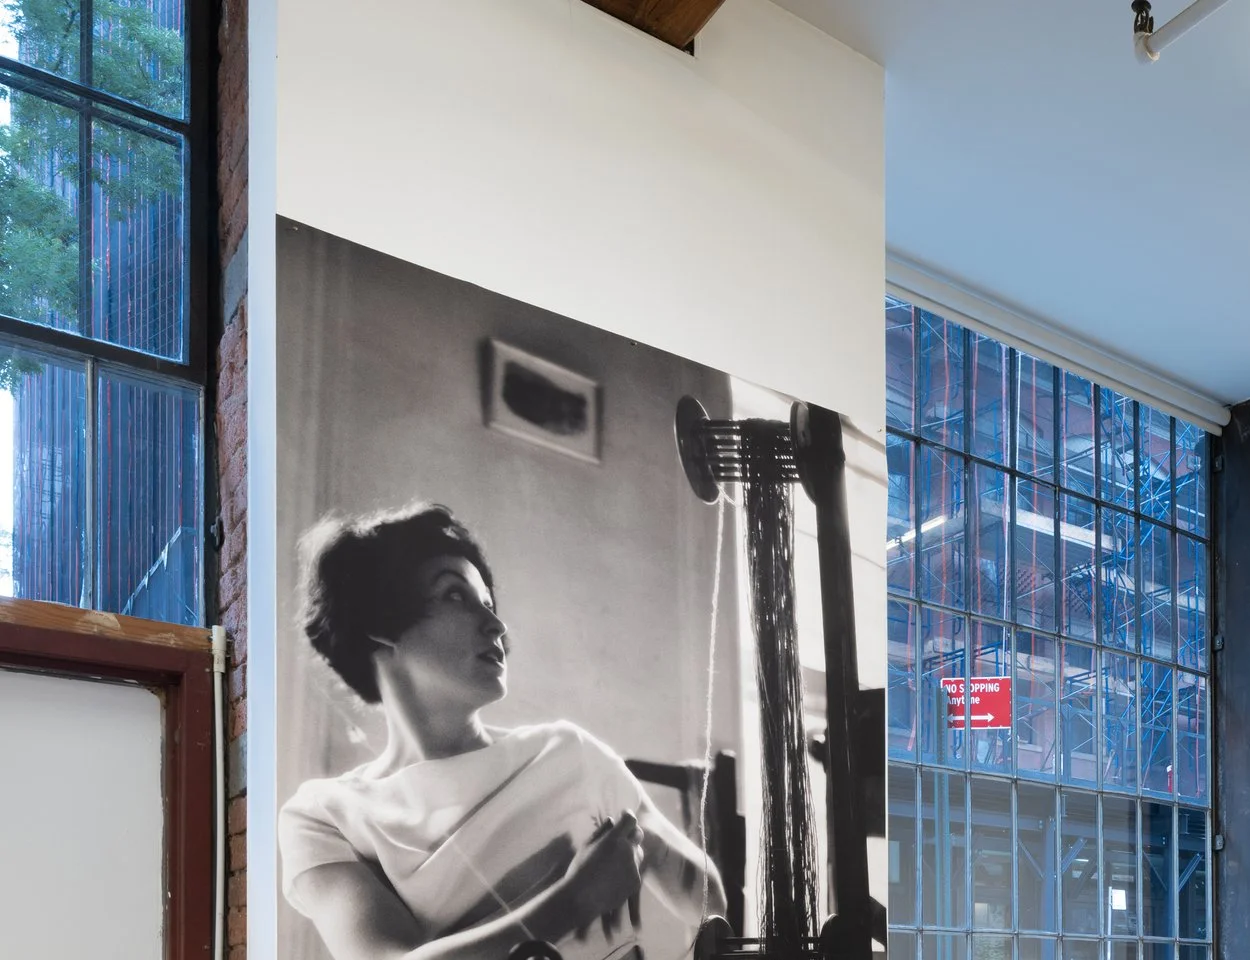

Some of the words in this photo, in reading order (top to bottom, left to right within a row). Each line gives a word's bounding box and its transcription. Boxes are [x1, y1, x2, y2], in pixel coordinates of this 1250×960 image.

[945, 684, 957, 693] NO
[959, 683, 1000, 693] SOPPING
[947, 696, 980, 707] Anytme
